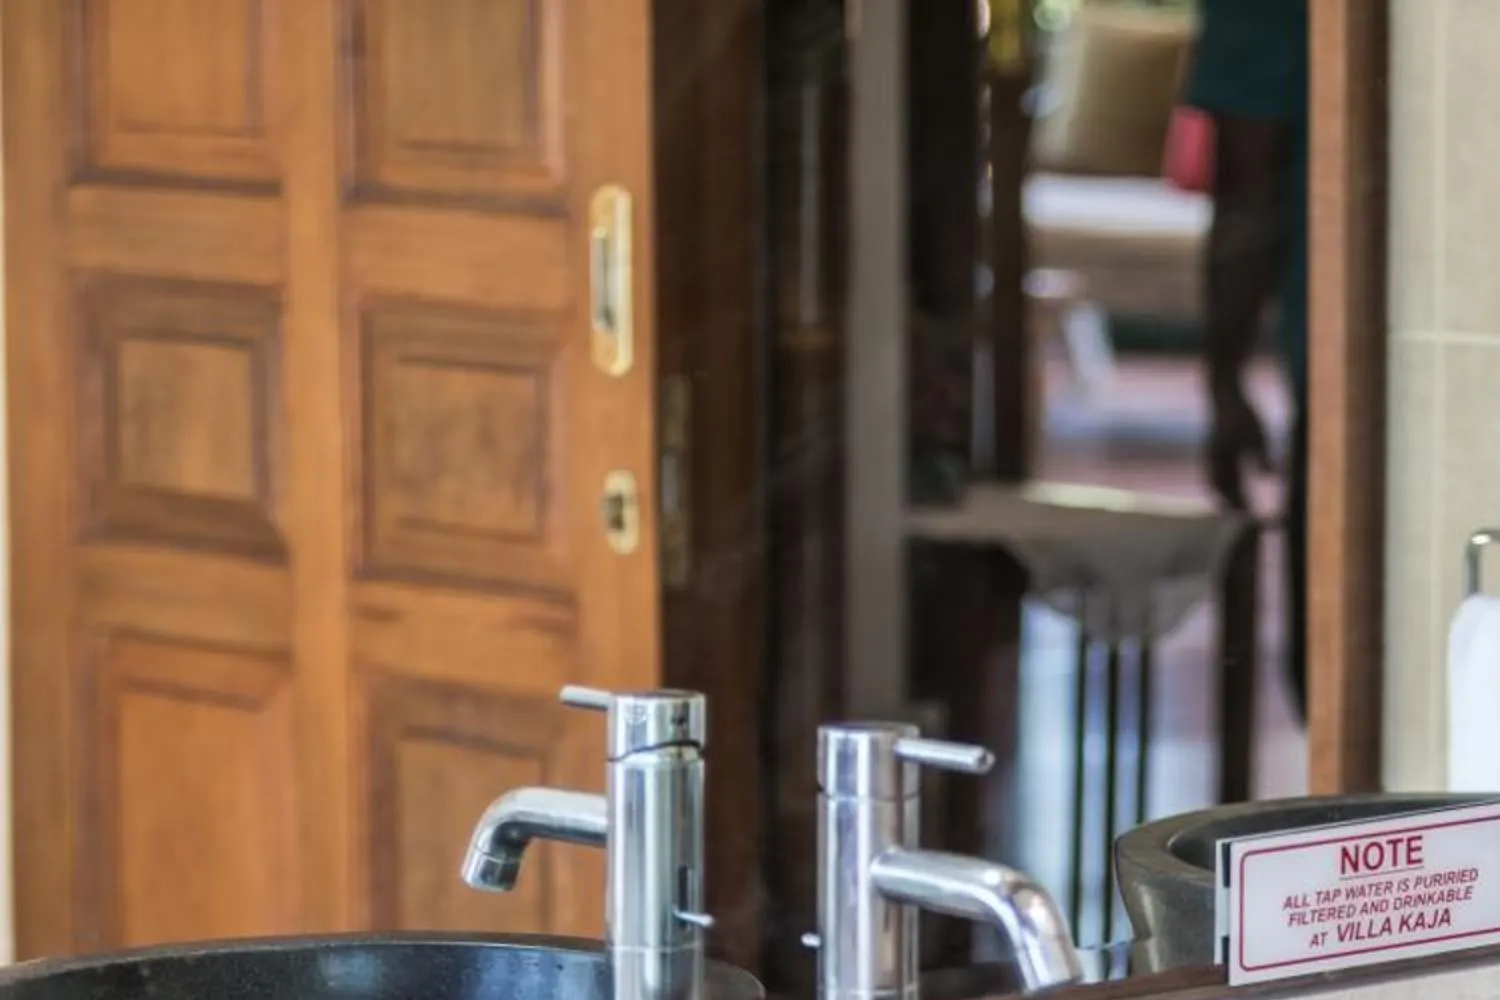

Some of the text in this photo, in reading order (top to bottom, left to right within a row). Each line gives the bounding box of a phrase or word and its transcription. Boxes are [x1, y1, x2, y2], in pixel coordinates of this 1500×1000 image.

[1339, 835, 1424, 876] NOTE
[1282, 893, 1311, 912] ALL
[1315, 888, 1341, 907] TAP
[1344, 880, 1394, 902] WATER
[1396, 878, 1411, 893] IS
[1287, 885, 1474, 928] FILTERED AND DRINKABLE
[1309, 907, 1452, 949] AT VILLA KAJA
